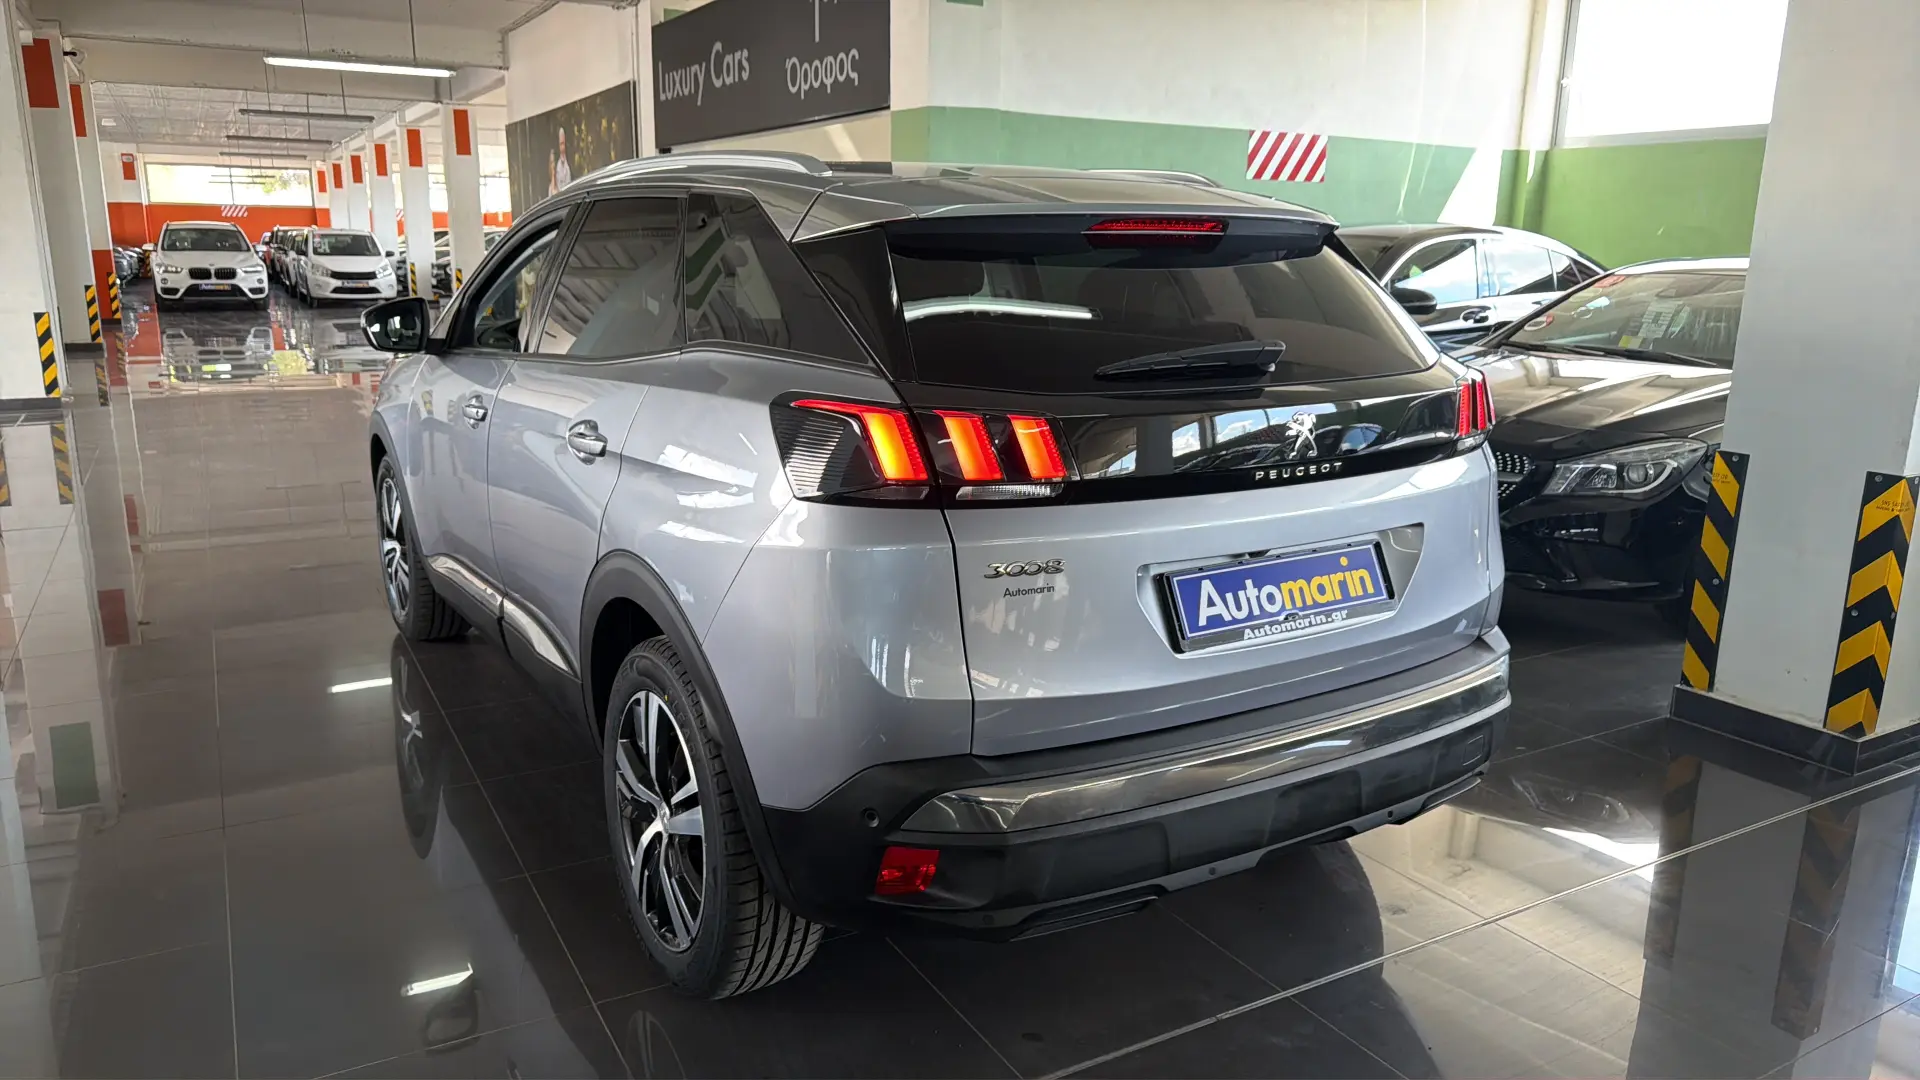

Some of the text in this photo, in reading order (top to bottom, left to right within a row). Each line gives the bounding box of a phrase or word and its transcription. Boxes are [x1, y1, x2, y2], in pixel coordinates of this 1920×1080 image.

[658, 41, 750, 106] Luxury Cars
[785, 48, 860, 100] Όροφος
[1255, 462, 1343, 481] PEUGEOT
[983, 558, 1066, 579] 3008
[1003, 583, 1055, 598] Automarin
[1198, 556, 1375, 627] Automarin
[1243, 609, 1349, 641] Automarin.gr
